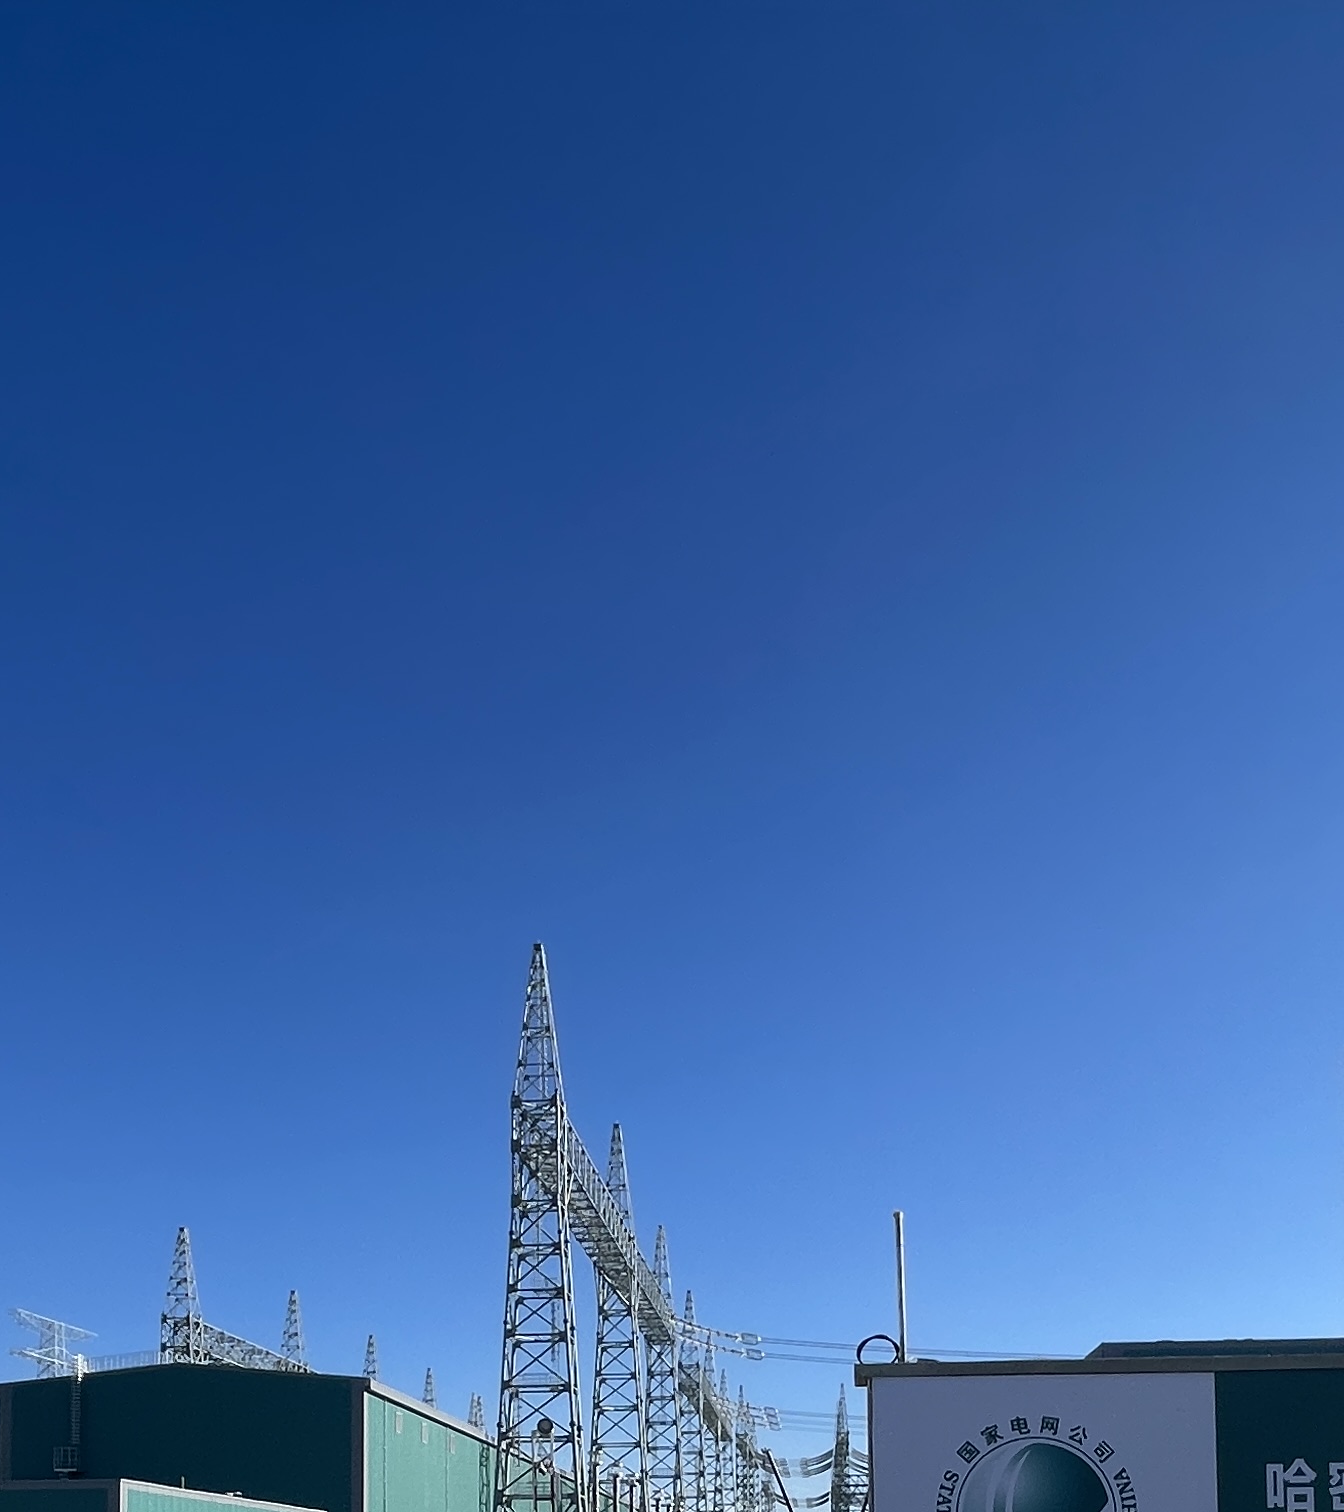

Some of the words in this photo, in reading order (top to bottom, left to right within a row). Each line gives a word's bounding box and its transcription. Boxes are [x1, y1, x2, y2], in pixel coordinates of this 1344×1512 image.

[956, 1415, 1116, 1464] 国家电网公司
